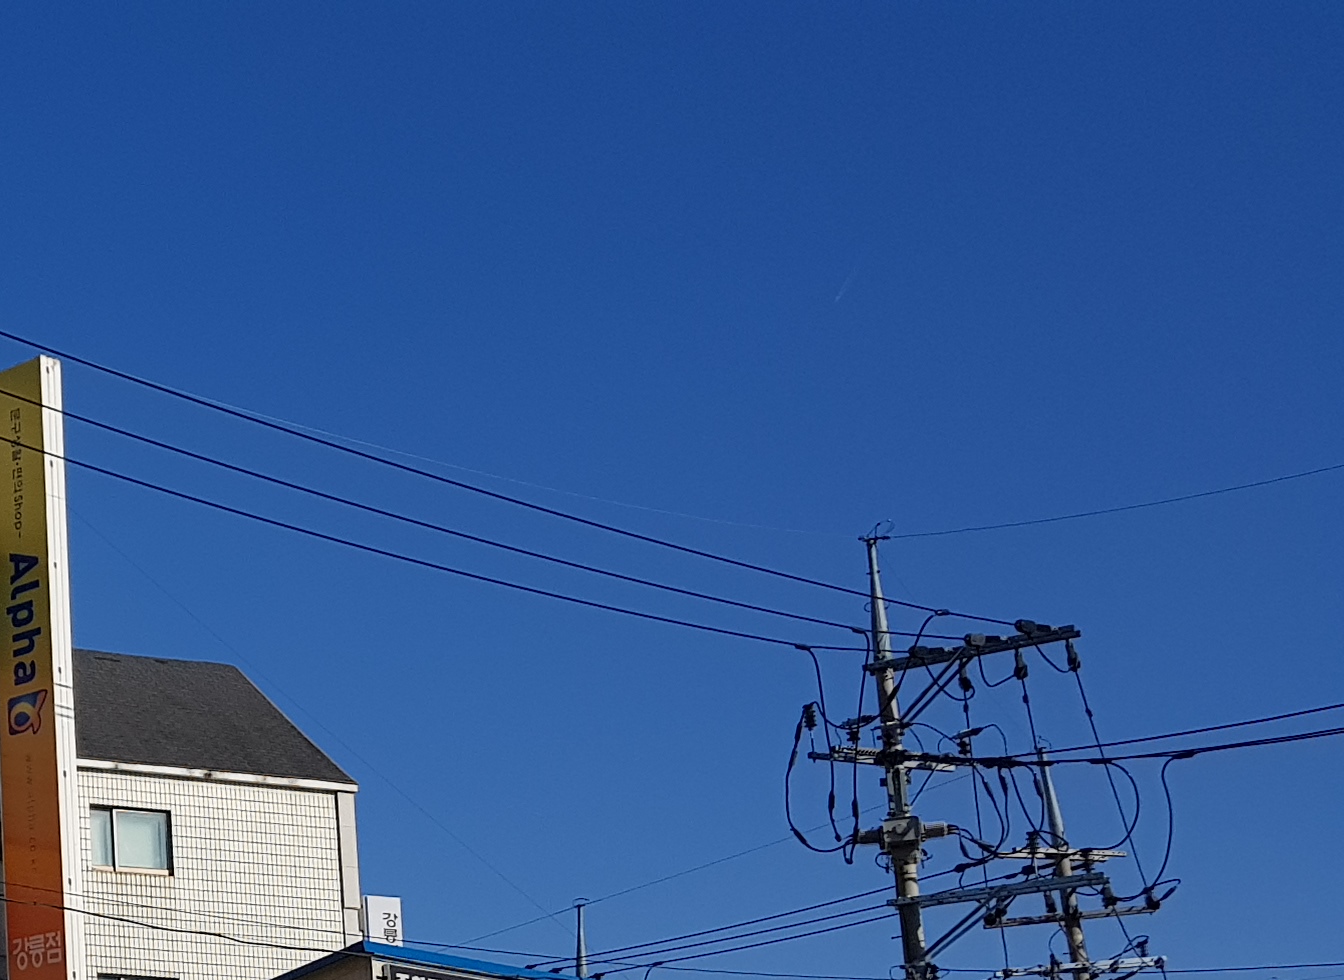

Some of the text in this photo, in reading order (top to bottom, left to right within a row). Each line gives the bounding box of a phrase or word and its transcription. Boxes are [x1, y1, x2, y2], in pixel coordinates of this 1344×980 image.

[6, 552, 41, 687] Alpha
[383, 912, 398, 943] 강릉
[13, 930, 62, 971] 강릉점
